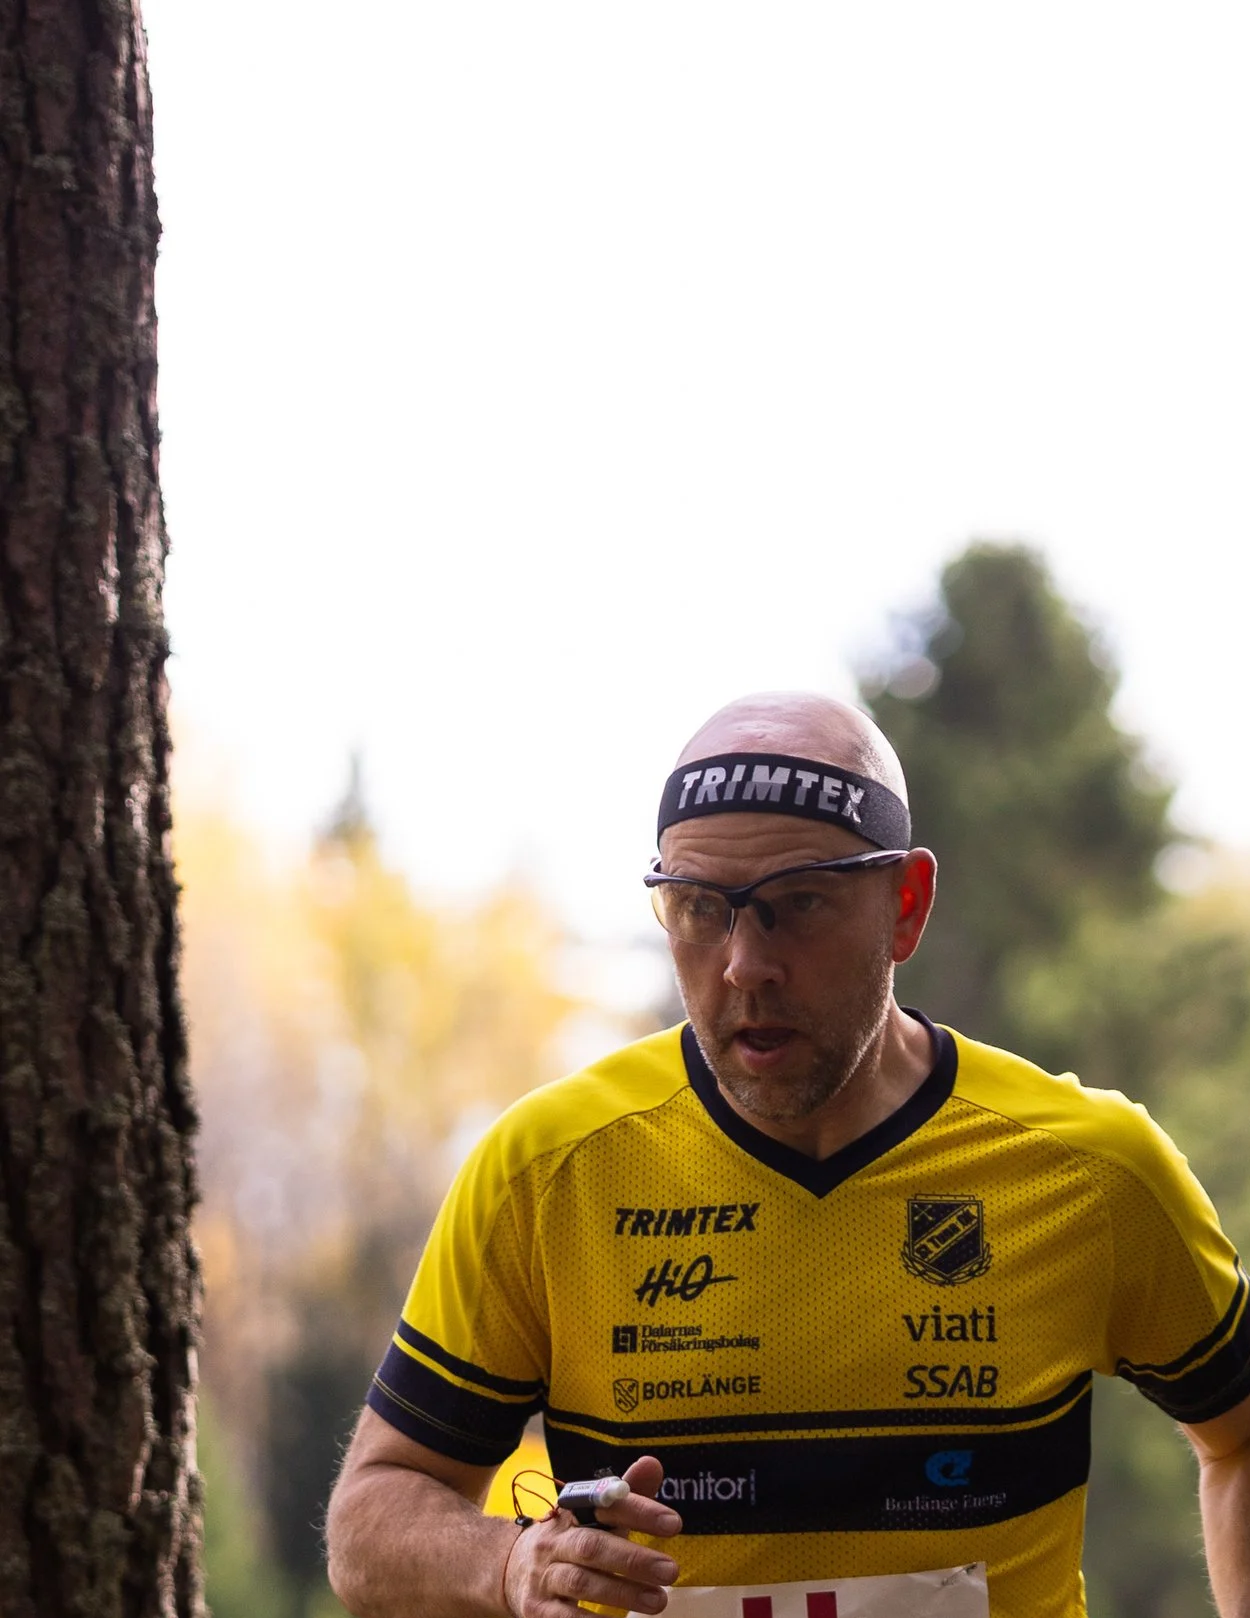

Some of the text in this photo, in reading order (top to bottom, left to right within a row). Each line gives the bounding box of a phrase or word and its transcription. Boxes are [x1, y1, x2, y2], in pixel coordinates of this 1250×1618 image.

[678, 764, 866, 824] TRIMTEX
[614, 1202, 761, 1237] TRIMTEX
[634, 1254, 739, 1307] HiQ
[642, 1323, 703, 1338] Dalarnas
[902, 1305, 999, 1342] viati
[641, 1334, 761, 1353] Försäkringsbolag
[642, 1373, 761, 1401] BORLÄNGE
[903, 1364, 999, 1398] SSAB
[656, 1470, 748, 1501] anitor
